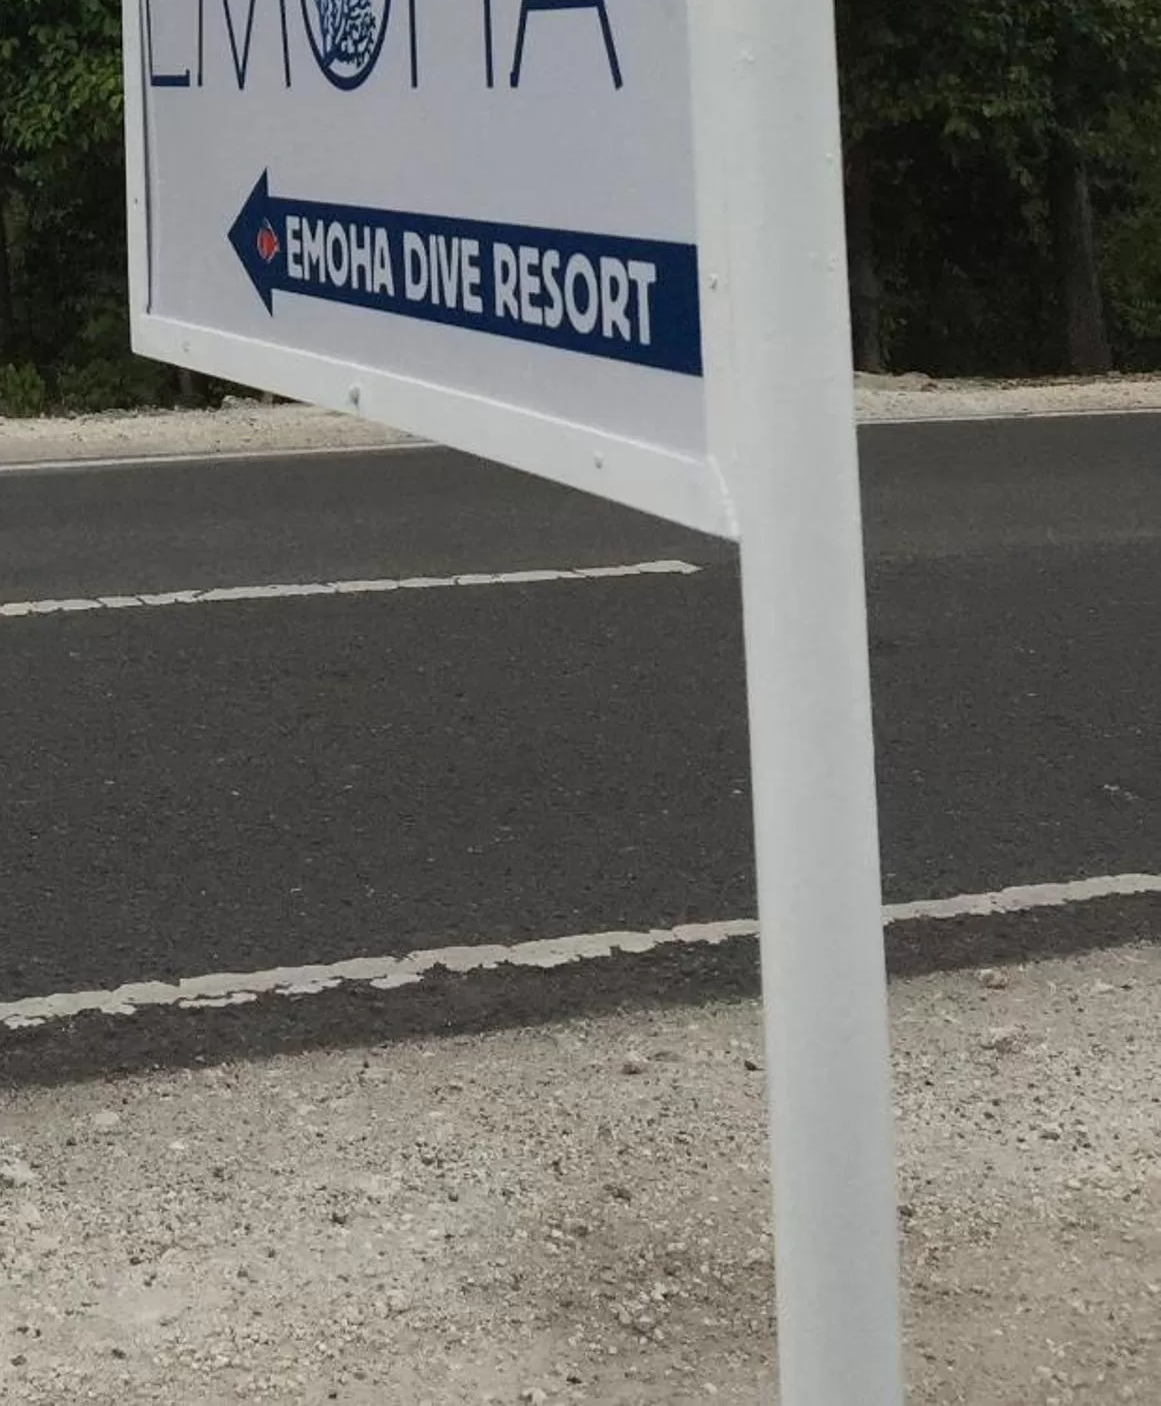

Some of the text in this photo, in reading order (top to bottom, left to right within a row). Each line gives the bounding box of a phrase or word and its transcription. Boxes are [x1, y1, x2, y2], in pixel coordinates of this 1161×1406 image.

[285, 215, 656, 345] EMOHA DIVE RESORT
